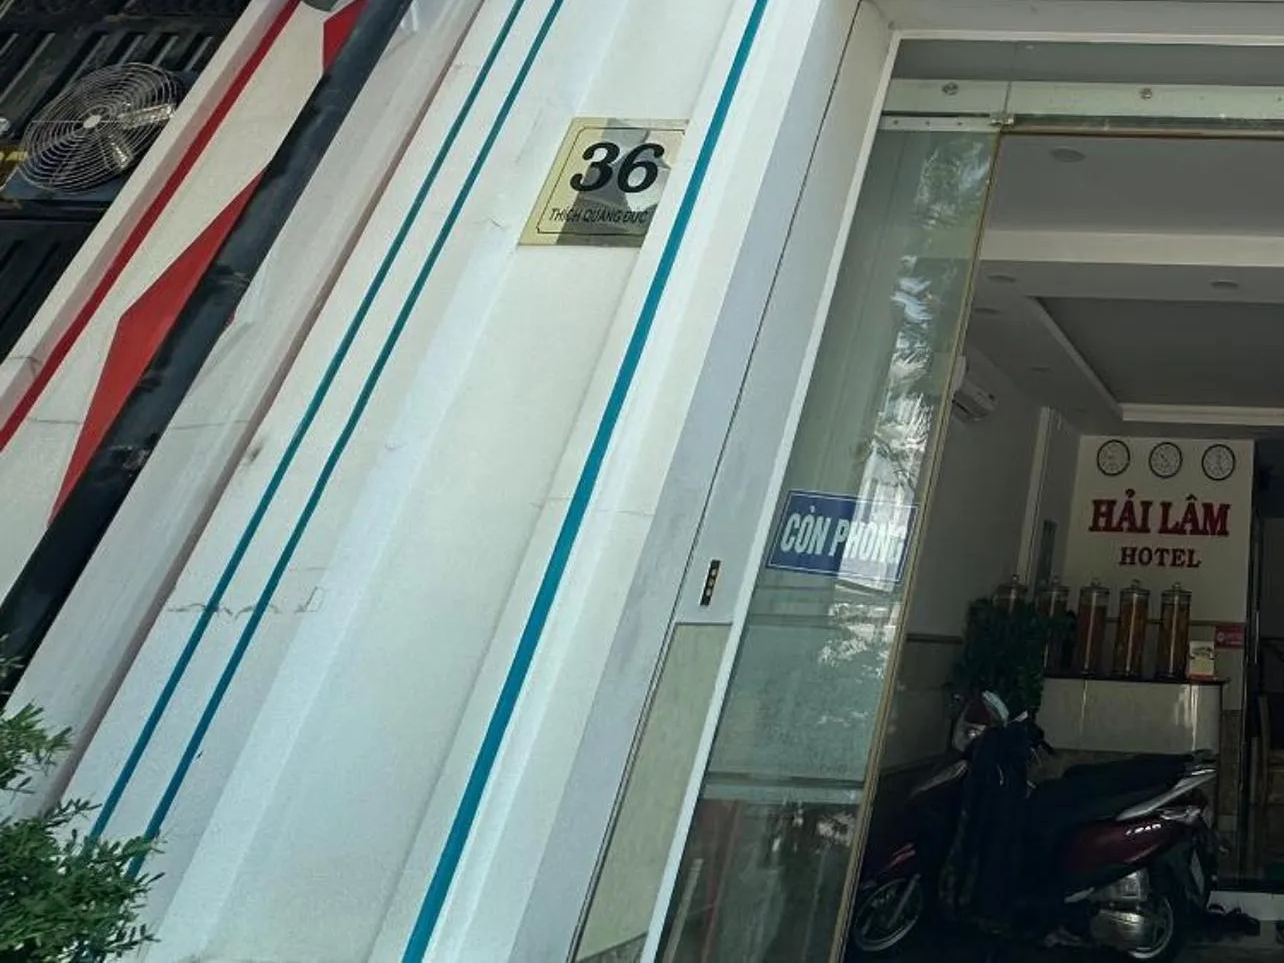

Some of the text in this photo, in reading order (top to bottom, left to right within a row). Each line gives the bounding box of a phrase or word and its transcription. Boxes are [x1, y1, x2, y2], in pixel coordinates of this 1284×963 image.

[569, 141, 666, 194] 36
[780, 504, 833, 556] CÒN
[1088, 488, 1232, 537] HẢI LÂM
[1118, 546, 1202, 569] HOTEL
